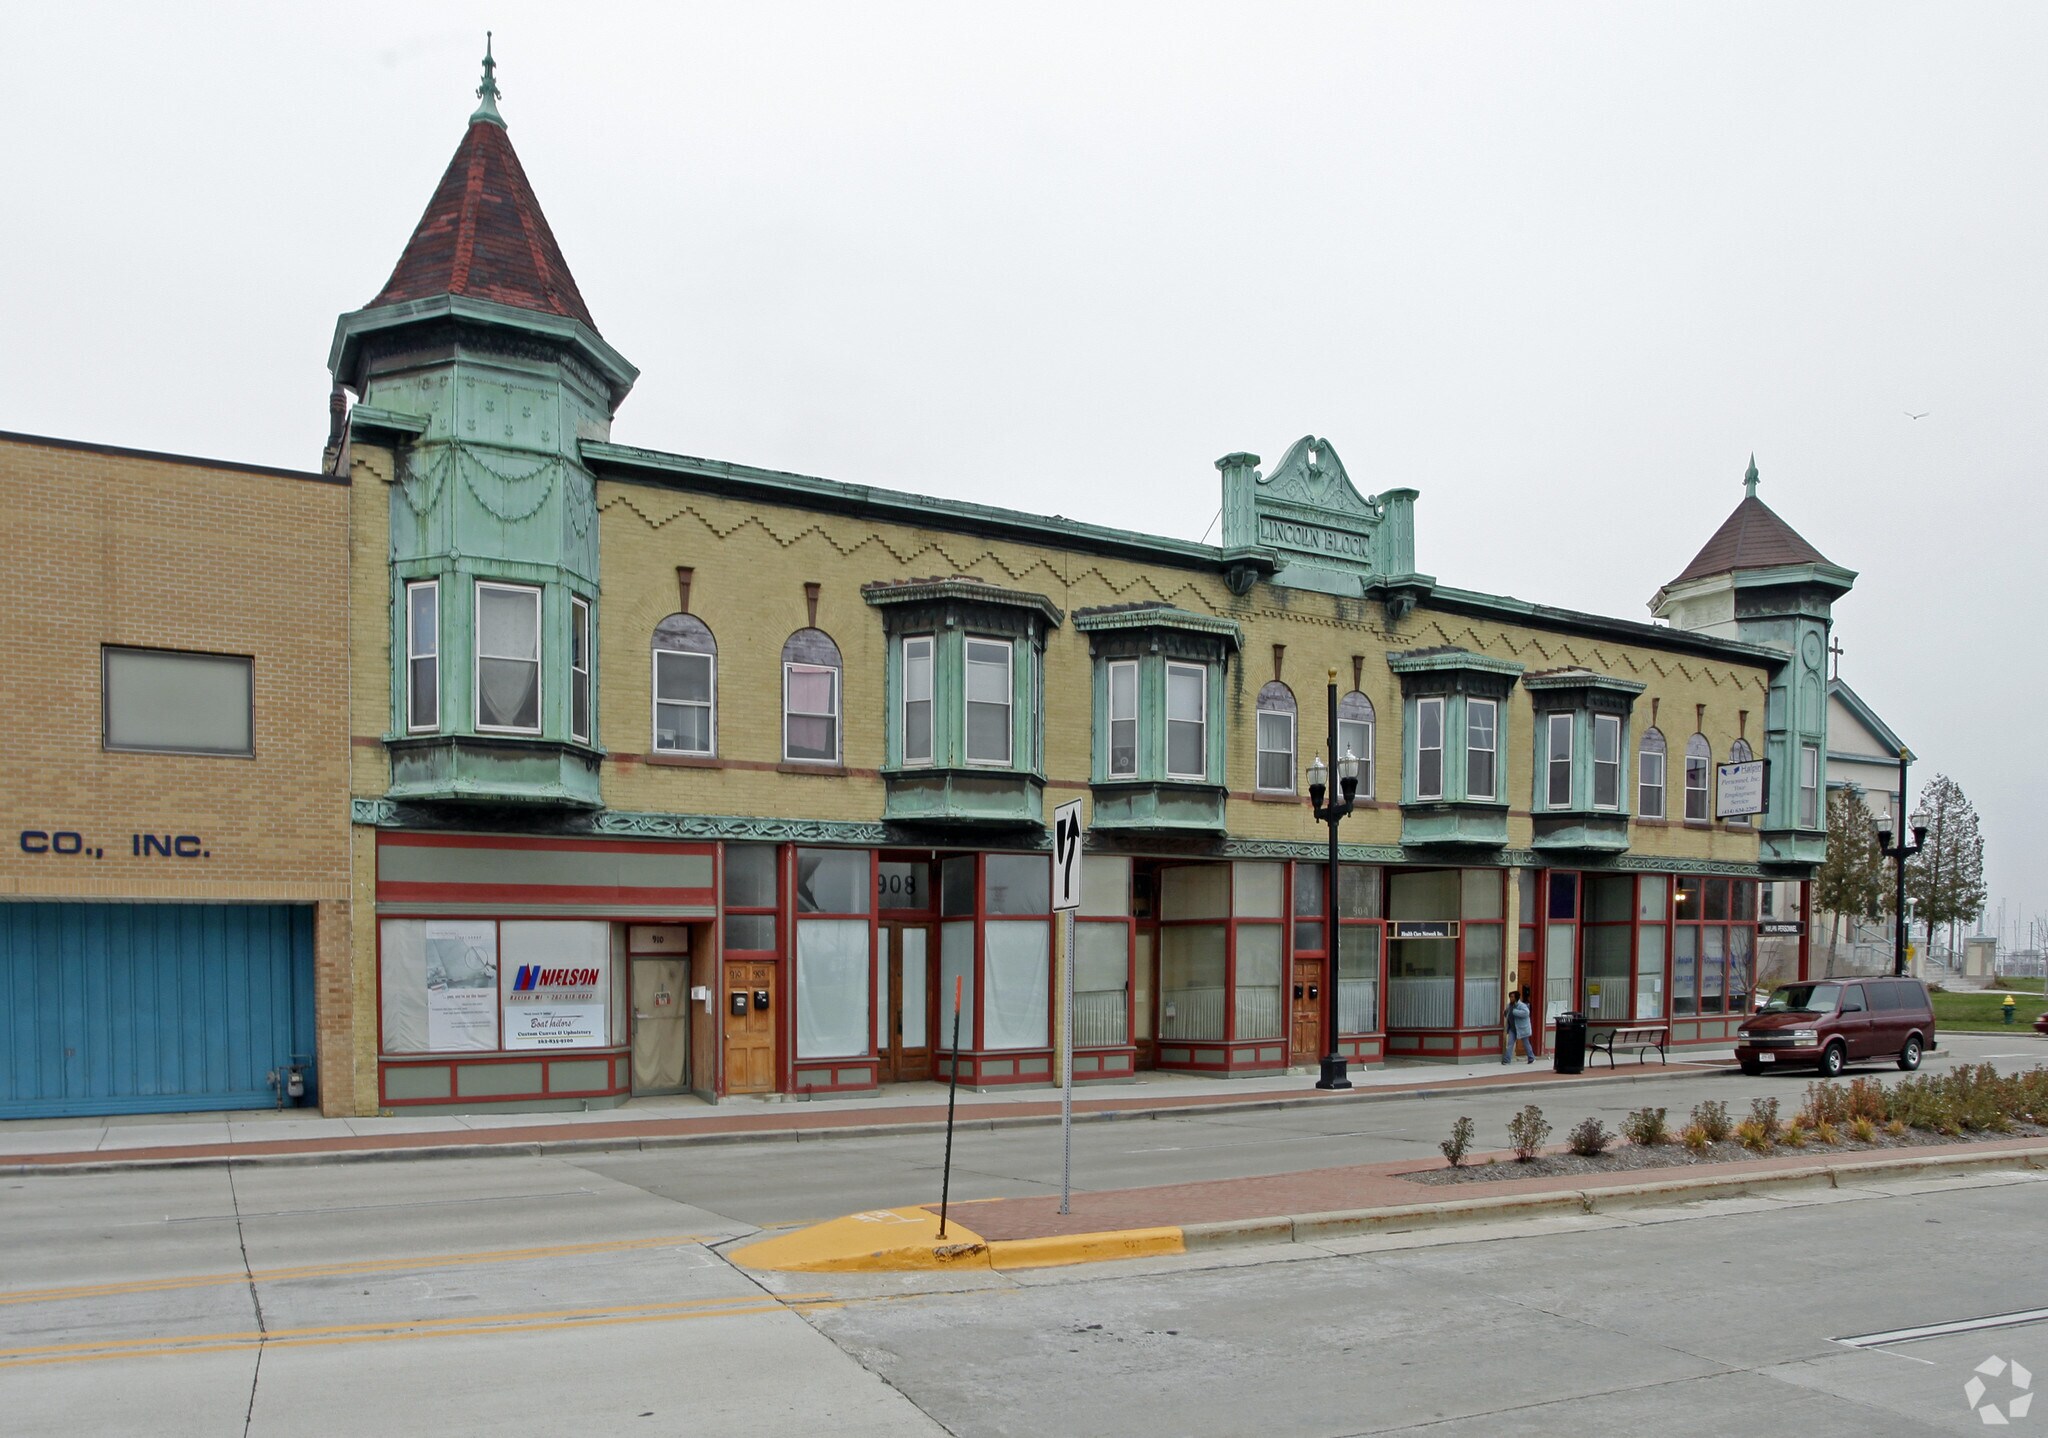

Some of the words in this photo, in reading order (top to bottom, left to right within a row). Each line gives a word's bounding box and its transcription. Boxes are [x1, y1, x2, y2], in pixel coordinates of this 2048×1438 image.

[1260, 519, 1320, 548] LINCOLN
[1324, 531, 1369, 557] BLOCK
[1741, 764, 1761, 775] Halpin
[1724, 791, 1756, 799] Employment
[20, 830, 104, 860] CO.,
[133, 833, 211, 858] INC.
[877, 873, 916, 895] 908
[1352, 906, 1369, 916] 904
[652, 935, 664, 944] 910
[539, 968, 599, 986] NIELSON
[530, 1018, 548, 1028] Boat
